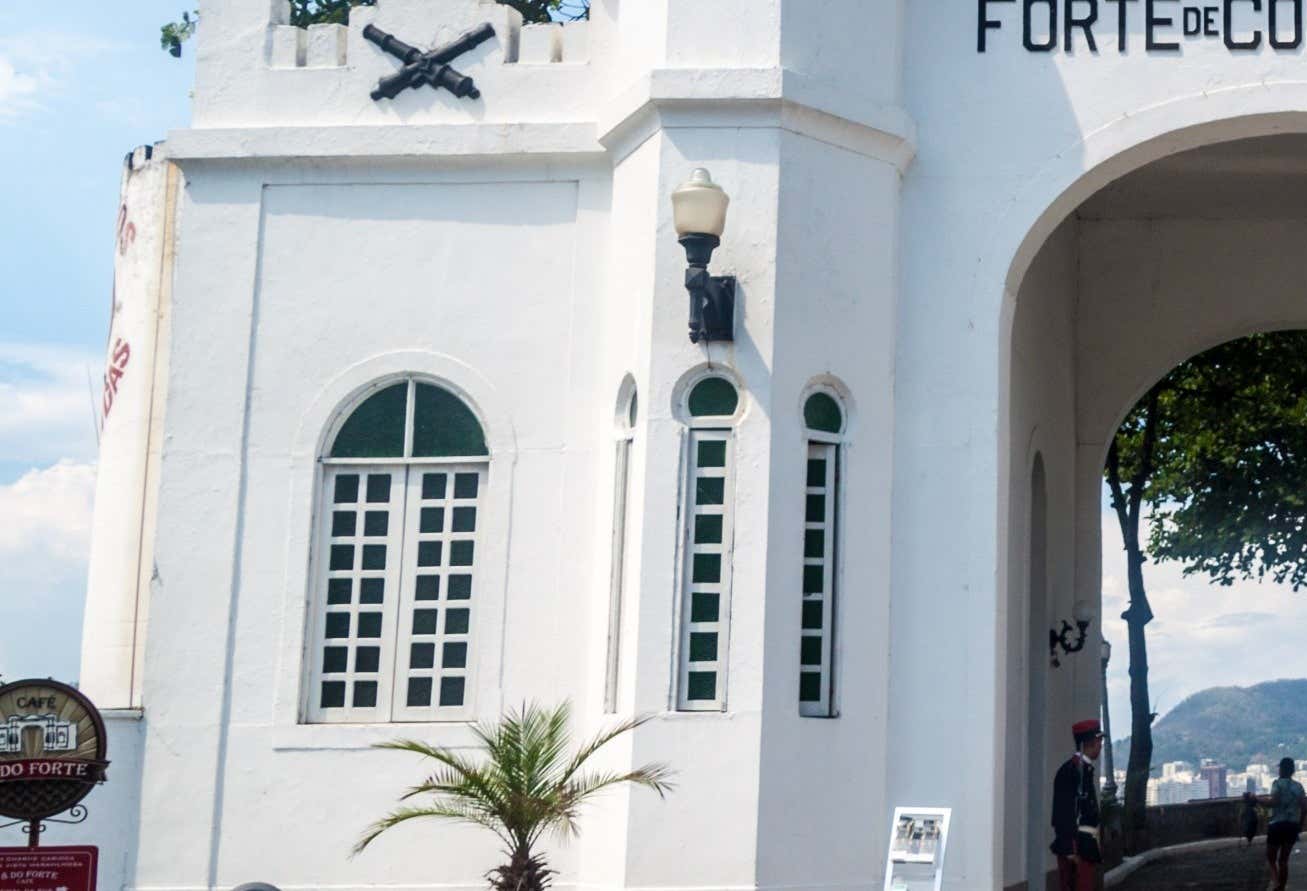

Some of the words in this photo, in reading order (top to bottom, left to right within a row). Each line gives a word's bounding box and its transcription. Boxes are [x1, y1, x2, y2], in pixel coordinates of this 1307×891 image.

[977, 0, 1181, 53] FORTE
[1183, 6, 1219, 37] DE
[17, 695, 56, 709] CAFÉ
[0, 763, 24, 777] DO
[29, 761, 88, 776] FORTE
